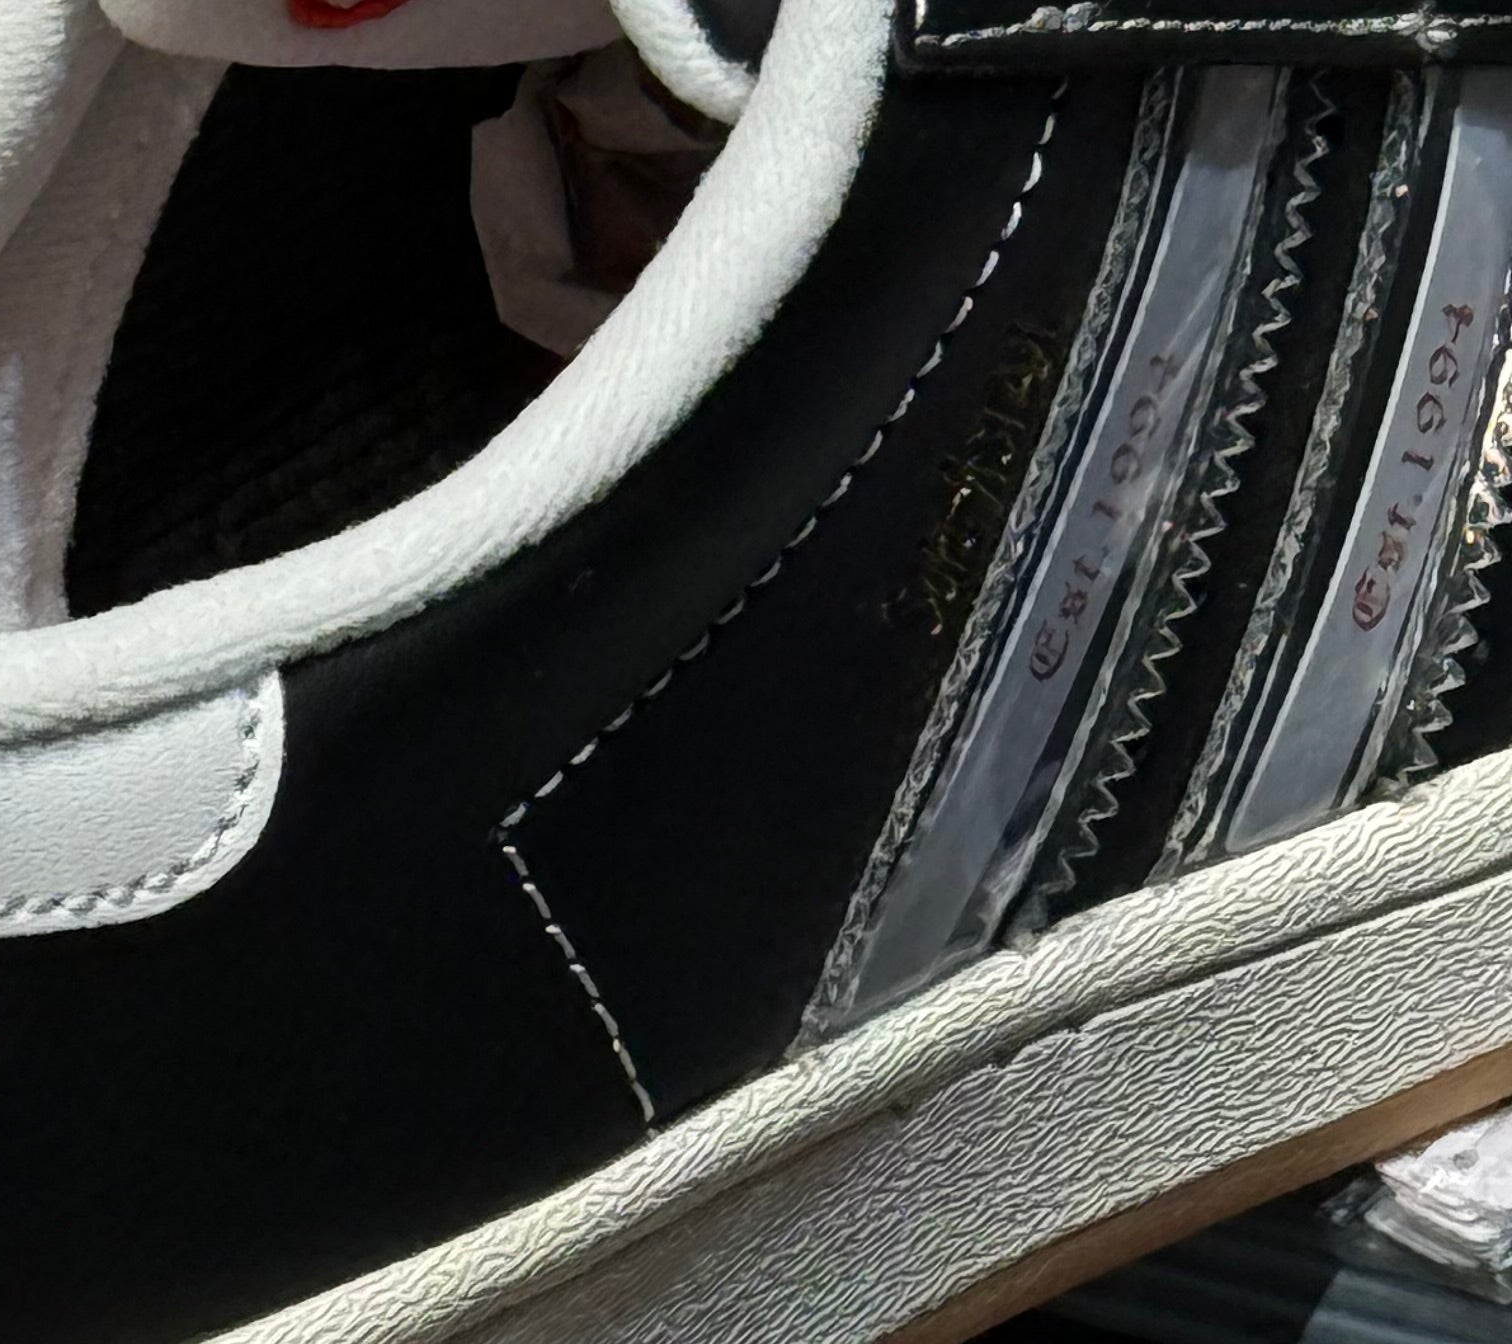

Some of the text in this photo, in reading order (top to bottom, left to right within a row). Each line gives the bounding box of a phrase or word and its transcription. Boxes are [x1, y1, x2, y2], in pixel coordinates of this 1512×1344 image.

[1091, 353, 1178, 520] 1994
[1352, 302, 1475, 632] Est. 1994
